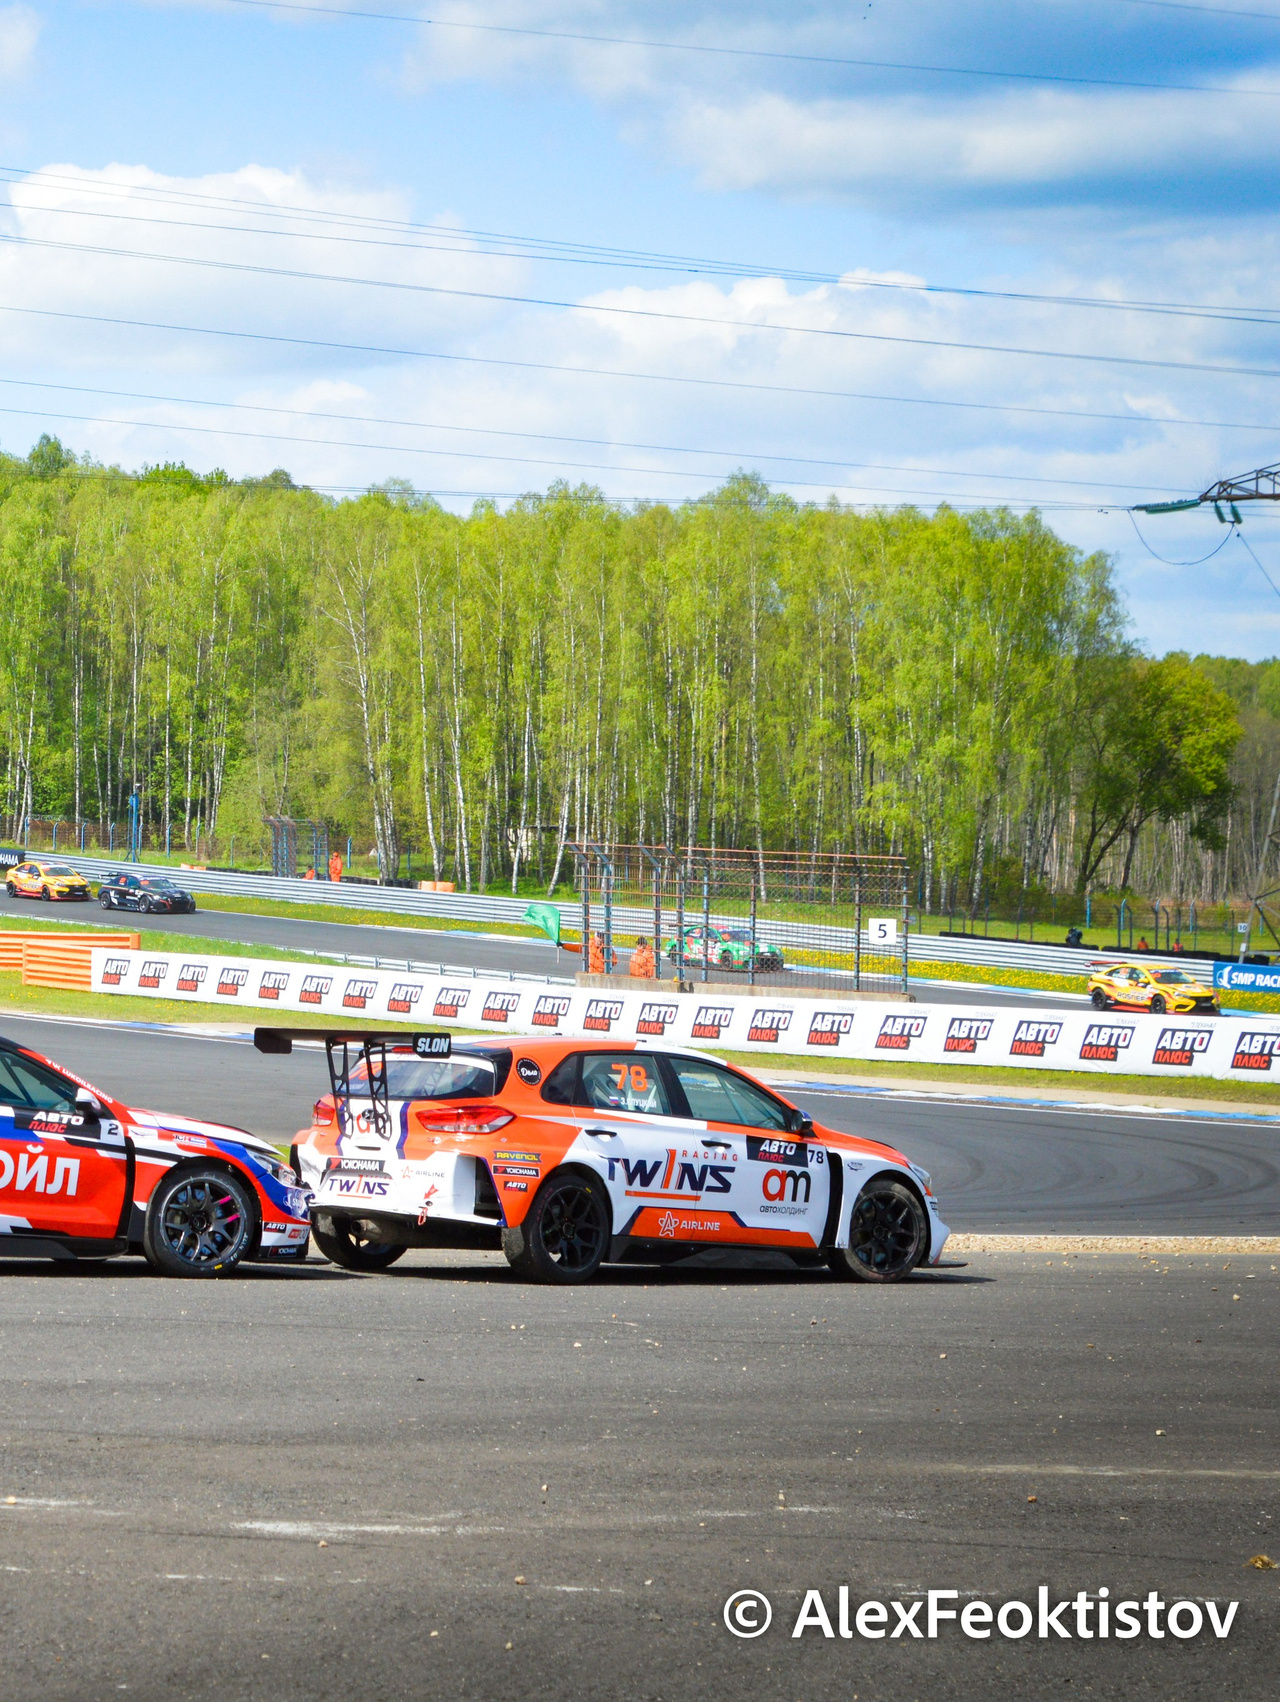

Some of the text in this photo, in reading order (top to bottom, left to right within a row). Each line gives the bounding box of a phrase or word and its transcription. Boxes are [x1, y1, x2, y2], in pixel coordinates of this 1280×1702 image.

[878, 924, 887, 938] 5
[104, 960, 129, 975] АВТО
[141, 963, 168, 978] АВТО
[179, 966, 207, 981] АВТО
[102, 974, 120, 984] ПЛЮС
[139, 976, 160, 987] ПЛЮС
[219, 969, 248, 985] АВТО
[261, 973, 289, 989] АВТО
[1231, 972, 1255, 985] SMP
[177, 980, 198, 991] ПЛЮС
[217, 983, 238, 995] ПЛЮС
[302, 977, 332, 993] АВТО
[345, 981, 377, 998] АВТО
[259, 987, 279, 999] ПЛЮС
[300, 991, 321, 1003] ПЛЮС
[390, 985, 423, 1002] АВТО
[436, 989, 470, 1006] АВТО
[344, 996, 365, 1007] ПЛЮС
[388, 1000, 410, 1012] ПЛЮС
[485, 994, 520, 1011] АВТО
[535, 997, 570, 1015] АВТО
[434, 1004, 457, 1016] ПЛЮС
[482, 1009, 507, 1021] ПЛЮС
[586, 1001, 622, 1019] АВТО
[640, 1005, 677, 1023] АВТО
[695, 1008, 732, 1026] АВТО
[533, 1013, 558, 1026] ПЛЮС
[584, 1018, 609, 1030] ПЛЮС
[751, 1011, 791, 1029] АВТО
[811, 1014, 852, 1033] АВТО
[880, 1017, 925, 1036] АВТО
[637, 1021, 663, 1034] ПЛЮС
[692, 1025, 719, 1037] ПЛЮС
[749, 1028, 778, 1041] ПЛЮС
[948, 1019, 992, 1038] АВТО
[1015, 1022, 1061, 1042] АВТО
[808, 1031, 838, 1044] ПЛЮС
[877, 1035, 908, 1047] ПЛЮС
[1083, 1026, 1133, 1046] АВТО
[1158, 1030, 1210, 1051] АВТО
[416, 1037, 450, 1053] SLON
[945, 1038, 975, 1051] ПЛЮС
[1012, 1041, 1043, 1055] ПЛЮС
[1081, 1045, 1116, 1059] ПЛЮС
[1154, 1050, 1191, 1064] ПЛЮС
[1233, 1054, 1269, 1068] ПЛЮС
[611, 1063, 648, 1092] 78
[62, 1067, 114, 1104] LUKOILRACING
[33, 1111, 84, 1126] АВТО
[28, 1121, 67, 1133] ПЛЮС
[107, 1123, 119, 1136] 2
[760, 1139, 797, 1155] АВТО
[496, 1152, 539, 1161] RAVENOL
[682, 1150, 738, 1161] RACING
[758, 1152, 785, 1163] ПЛЮС
[808, 1149, 824, 1164] 78
[341, 1159, 380, 1171] YOKOHAMA
[506, 1167, 537, 1176] YOKOHAMA
[598, 1148, 736, 1193] TWINS
[415, 1170, 445, 1178] AIRLINE
[329, 1175, 390, 1195] TWINS
[506, 1181, 527, 1189] АВТО
[760, 1205, 808, 1216] автохолдинг
[266, 1222, 285, 1230] АВТО
[680, 1220, 721, 1231] AIRLINE
